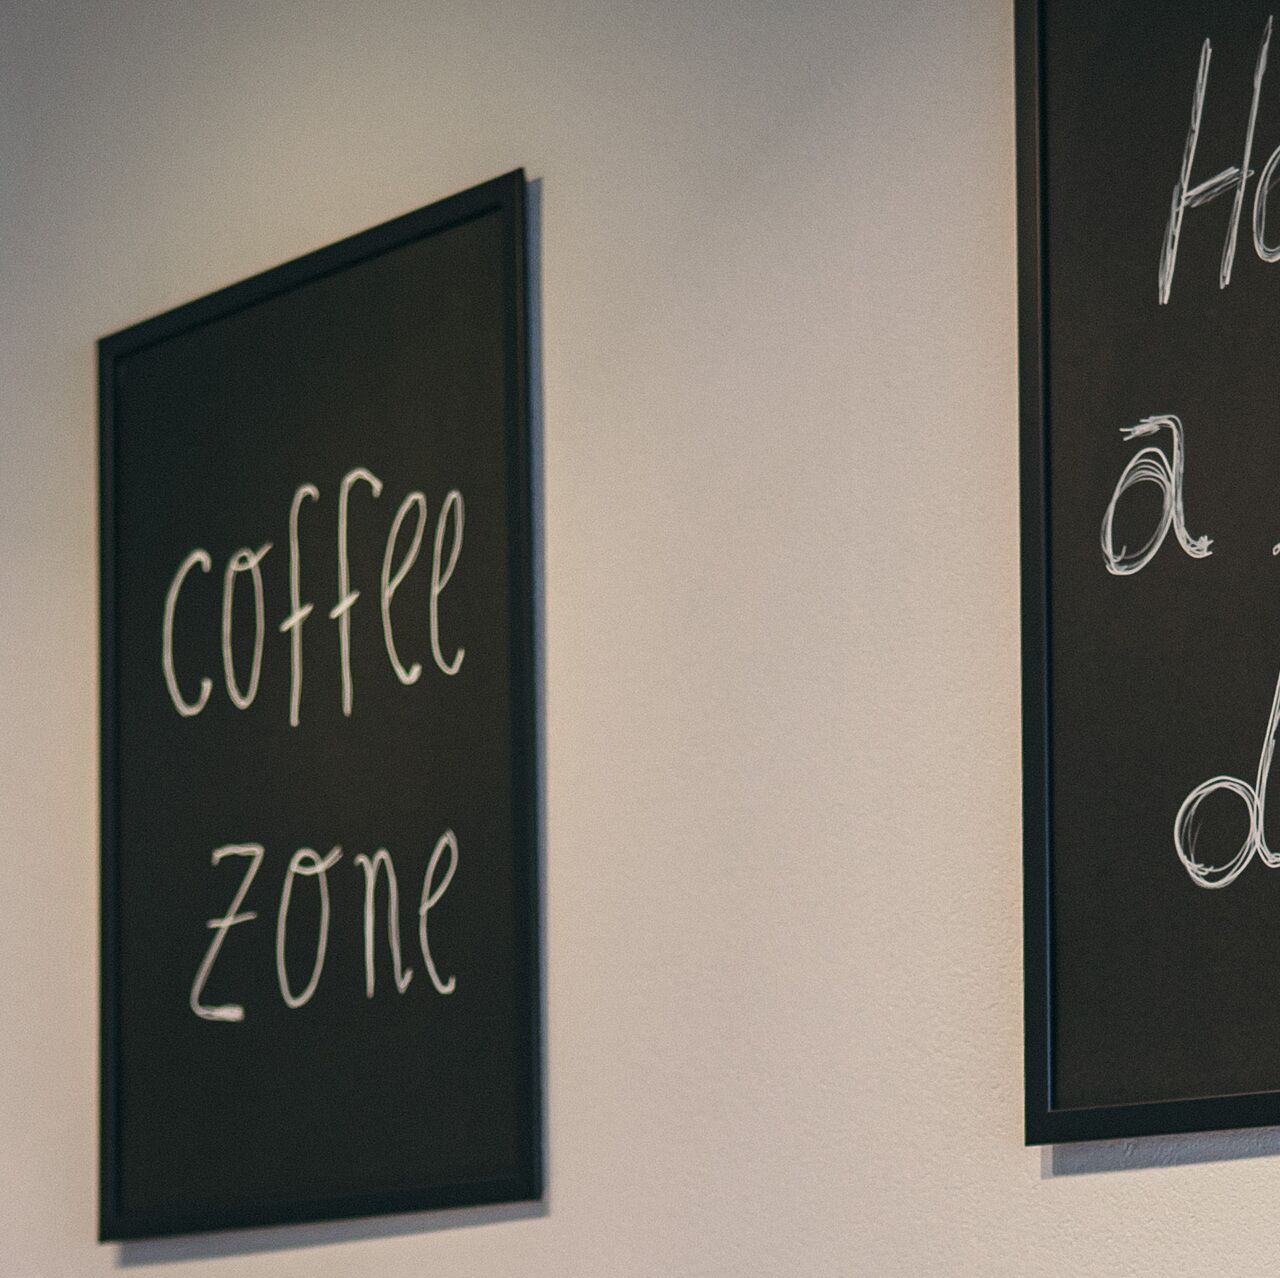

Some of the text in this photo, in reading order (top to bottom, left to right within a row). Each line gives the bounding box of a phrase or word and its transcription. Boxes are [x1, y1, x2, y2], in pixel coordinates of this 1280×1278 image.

[1100, 413, 1215, 577] a
[162, 467, 466, 728] coffee
[190, 830, 460, 1022] zone
